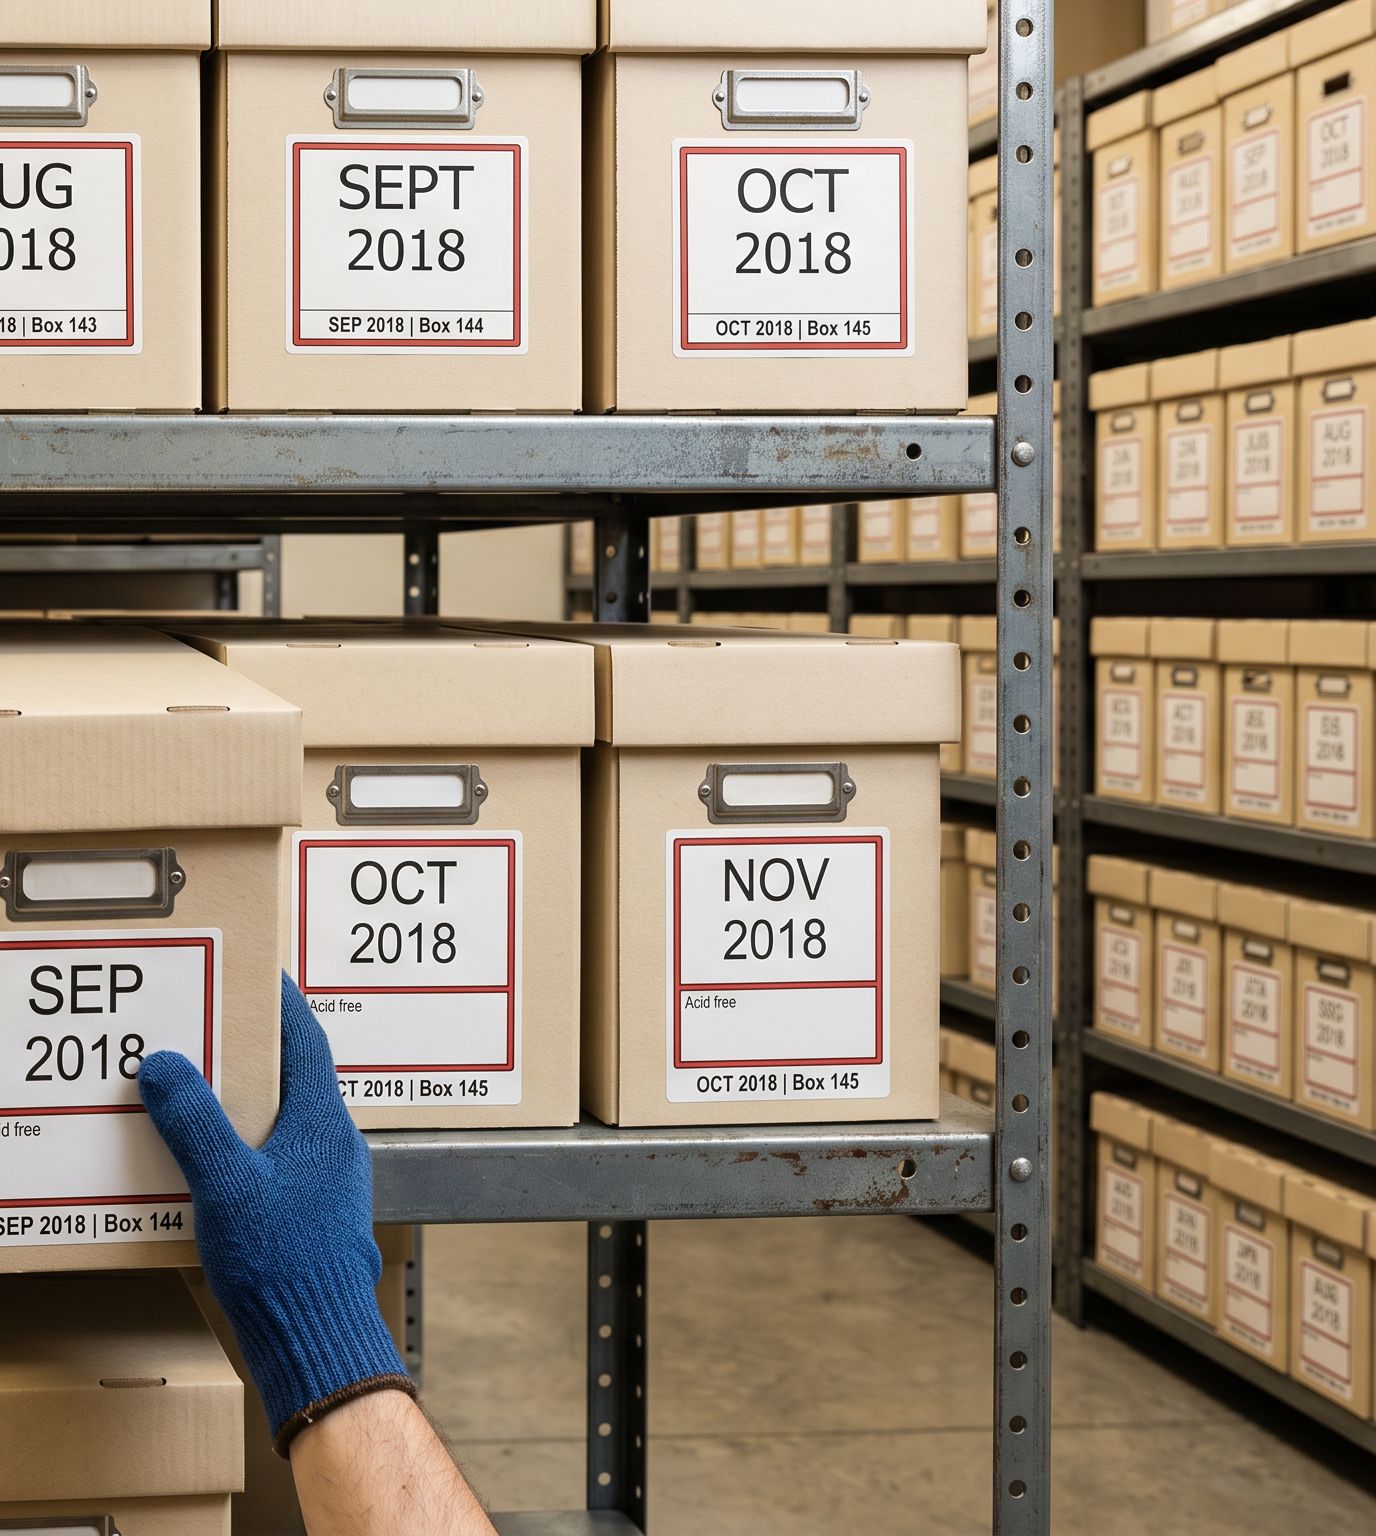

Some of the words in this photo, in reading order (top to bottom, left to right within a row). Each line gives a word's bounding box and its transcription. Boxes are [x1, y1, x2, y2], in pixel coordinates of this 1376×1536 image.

[340, 164, 474, 209] SEPT
[738, 168, 849, 213] OCT
[349, 229, 465, 271] 2018
[736, 232, 851, 274] 2018
[32, 317, 63, 332] Box
[70, 317, 96, 332] 143
[329, 317, 361, 332] SEP
[367, 317, 404, 332] 2018
[420, 318, 450, 333] Box
[457, 318, 483, 333] 144
[716, 320, 750, 336] OCT
[756, 320, 792, 335] 2018
[808, 321, 838, 335] Box
[844, 320, 870, 335] 145
[351, 861, 457, 905] OCT
[725, 858, 829, 901] NOV
[350, 923, 456, 963] 2018
[724, 919, 826, 959] 2018
[29, 964, 143, 1015] SEP
[310, 1000, 334, 1012] Acid
[339, 999, 362, 1012] free
[685, 996, 710, 1008] Acid
[714, 996, 736, 1008] free
[26, 1034, 144, 1081] 2018
[364, 1080, 403, 1097] 2018
[420, 1080, 452, 1096] Box
[459, 1080, 488, 1096] 145
[697, 1076, 733, 1092] OCT
[739, 1074, 777, 1091] 2018
[794, 1074, 824, 1090] Box
[831, 1073, 858, 1089] 145
[14, 1122, 40, 1136] free
[40, 1215, 85, 1234] 2018
[105, 1214, 142, 1232] Box
[150, 1212, 183, 1231] 144
